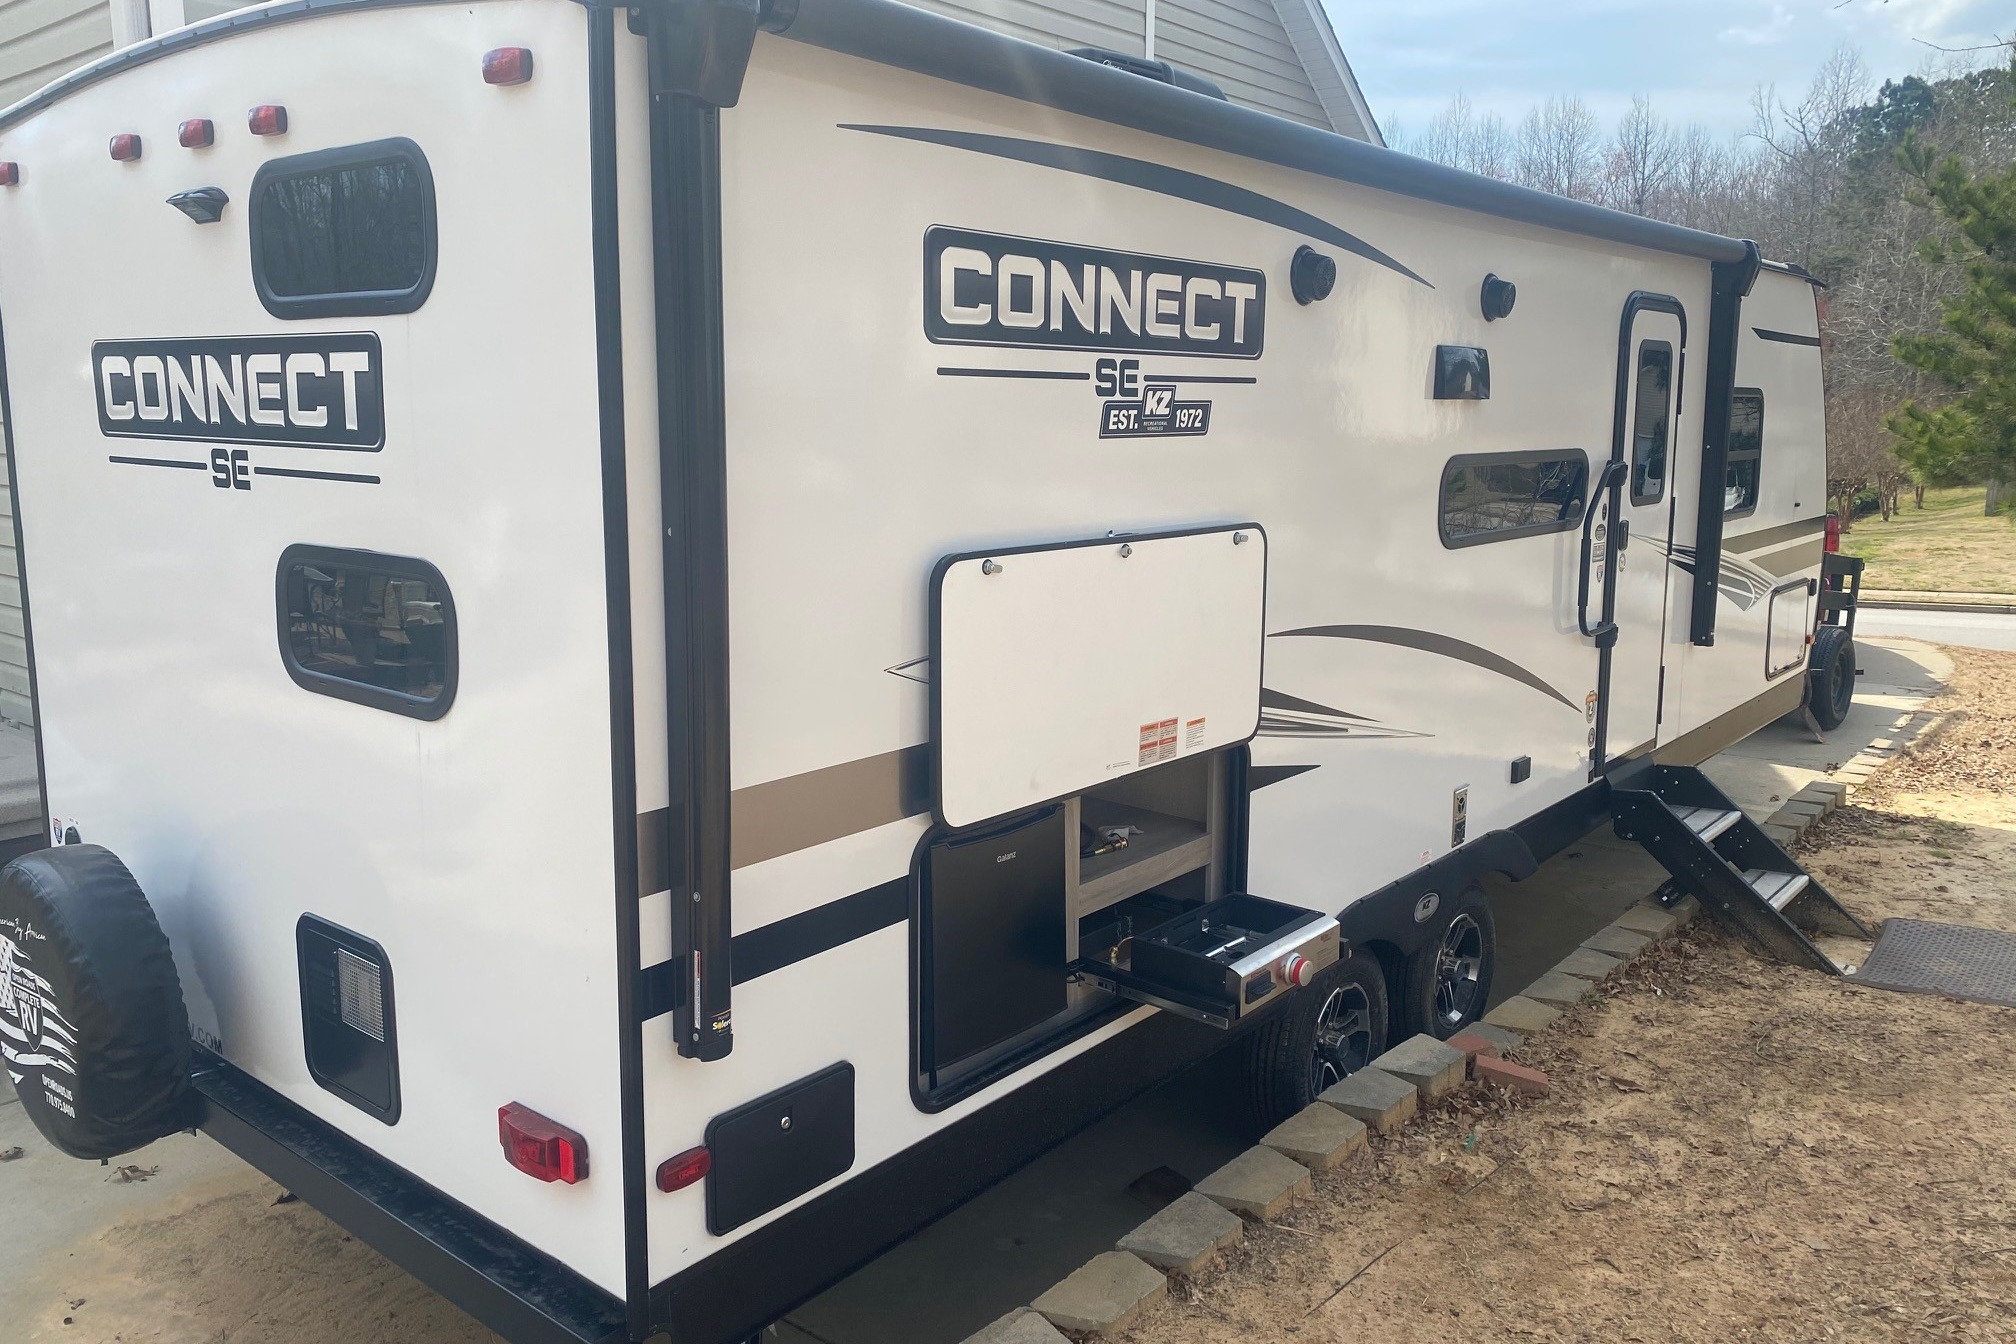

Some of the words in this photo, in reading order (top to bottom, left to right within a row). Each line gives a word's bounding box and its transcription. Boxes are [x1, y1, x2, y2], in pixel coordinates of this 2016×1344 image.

[939, 245, 1257, 344] CONNECT
[100, 351, 370, 431] CONNECT
[1095, 357, 1139, 398] SE
[1108, 409, 1139, 430] EST.
[1175, 408, 1203, 428] 1972
[1144, 390, 1173, 415] KZ
[210, 447, 252, 491] SE
[996, 850, 1017, 863] Galanz
[13, 986, 41, 1009] COMPLETE
[19, 1000, 38, 1036] RV
